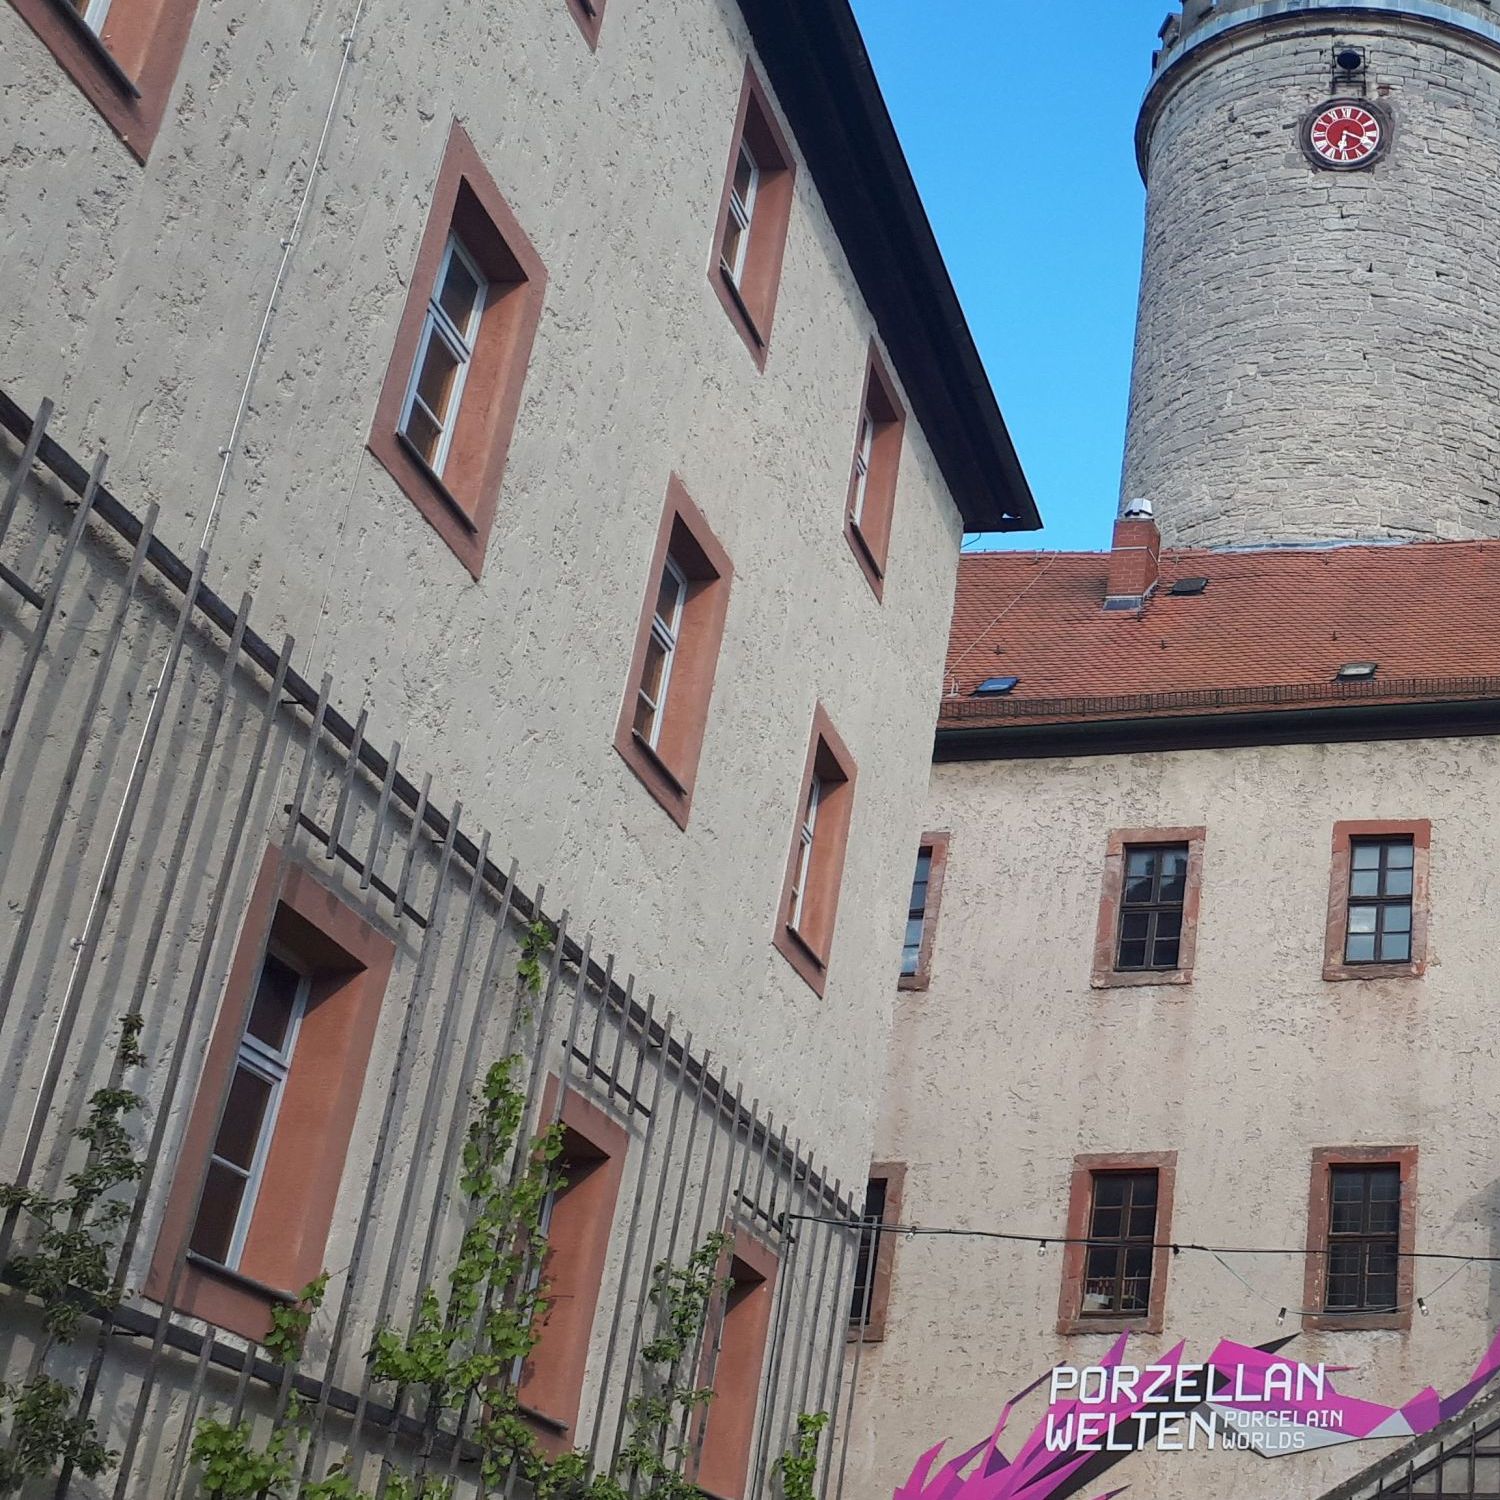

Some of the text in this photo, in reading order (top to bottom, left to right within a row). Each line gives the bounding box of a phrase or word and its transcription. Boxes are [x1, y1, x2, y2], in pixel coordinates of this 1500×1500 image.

[1049, 1362, 1325, 1404] PORZELLAN
[1045, 1411, 1217, 1451] WELTEN
[1223, 1410, 1343, 1428] PORCELAIN
[1222, 1432, 1305, 1450] WORLDS
